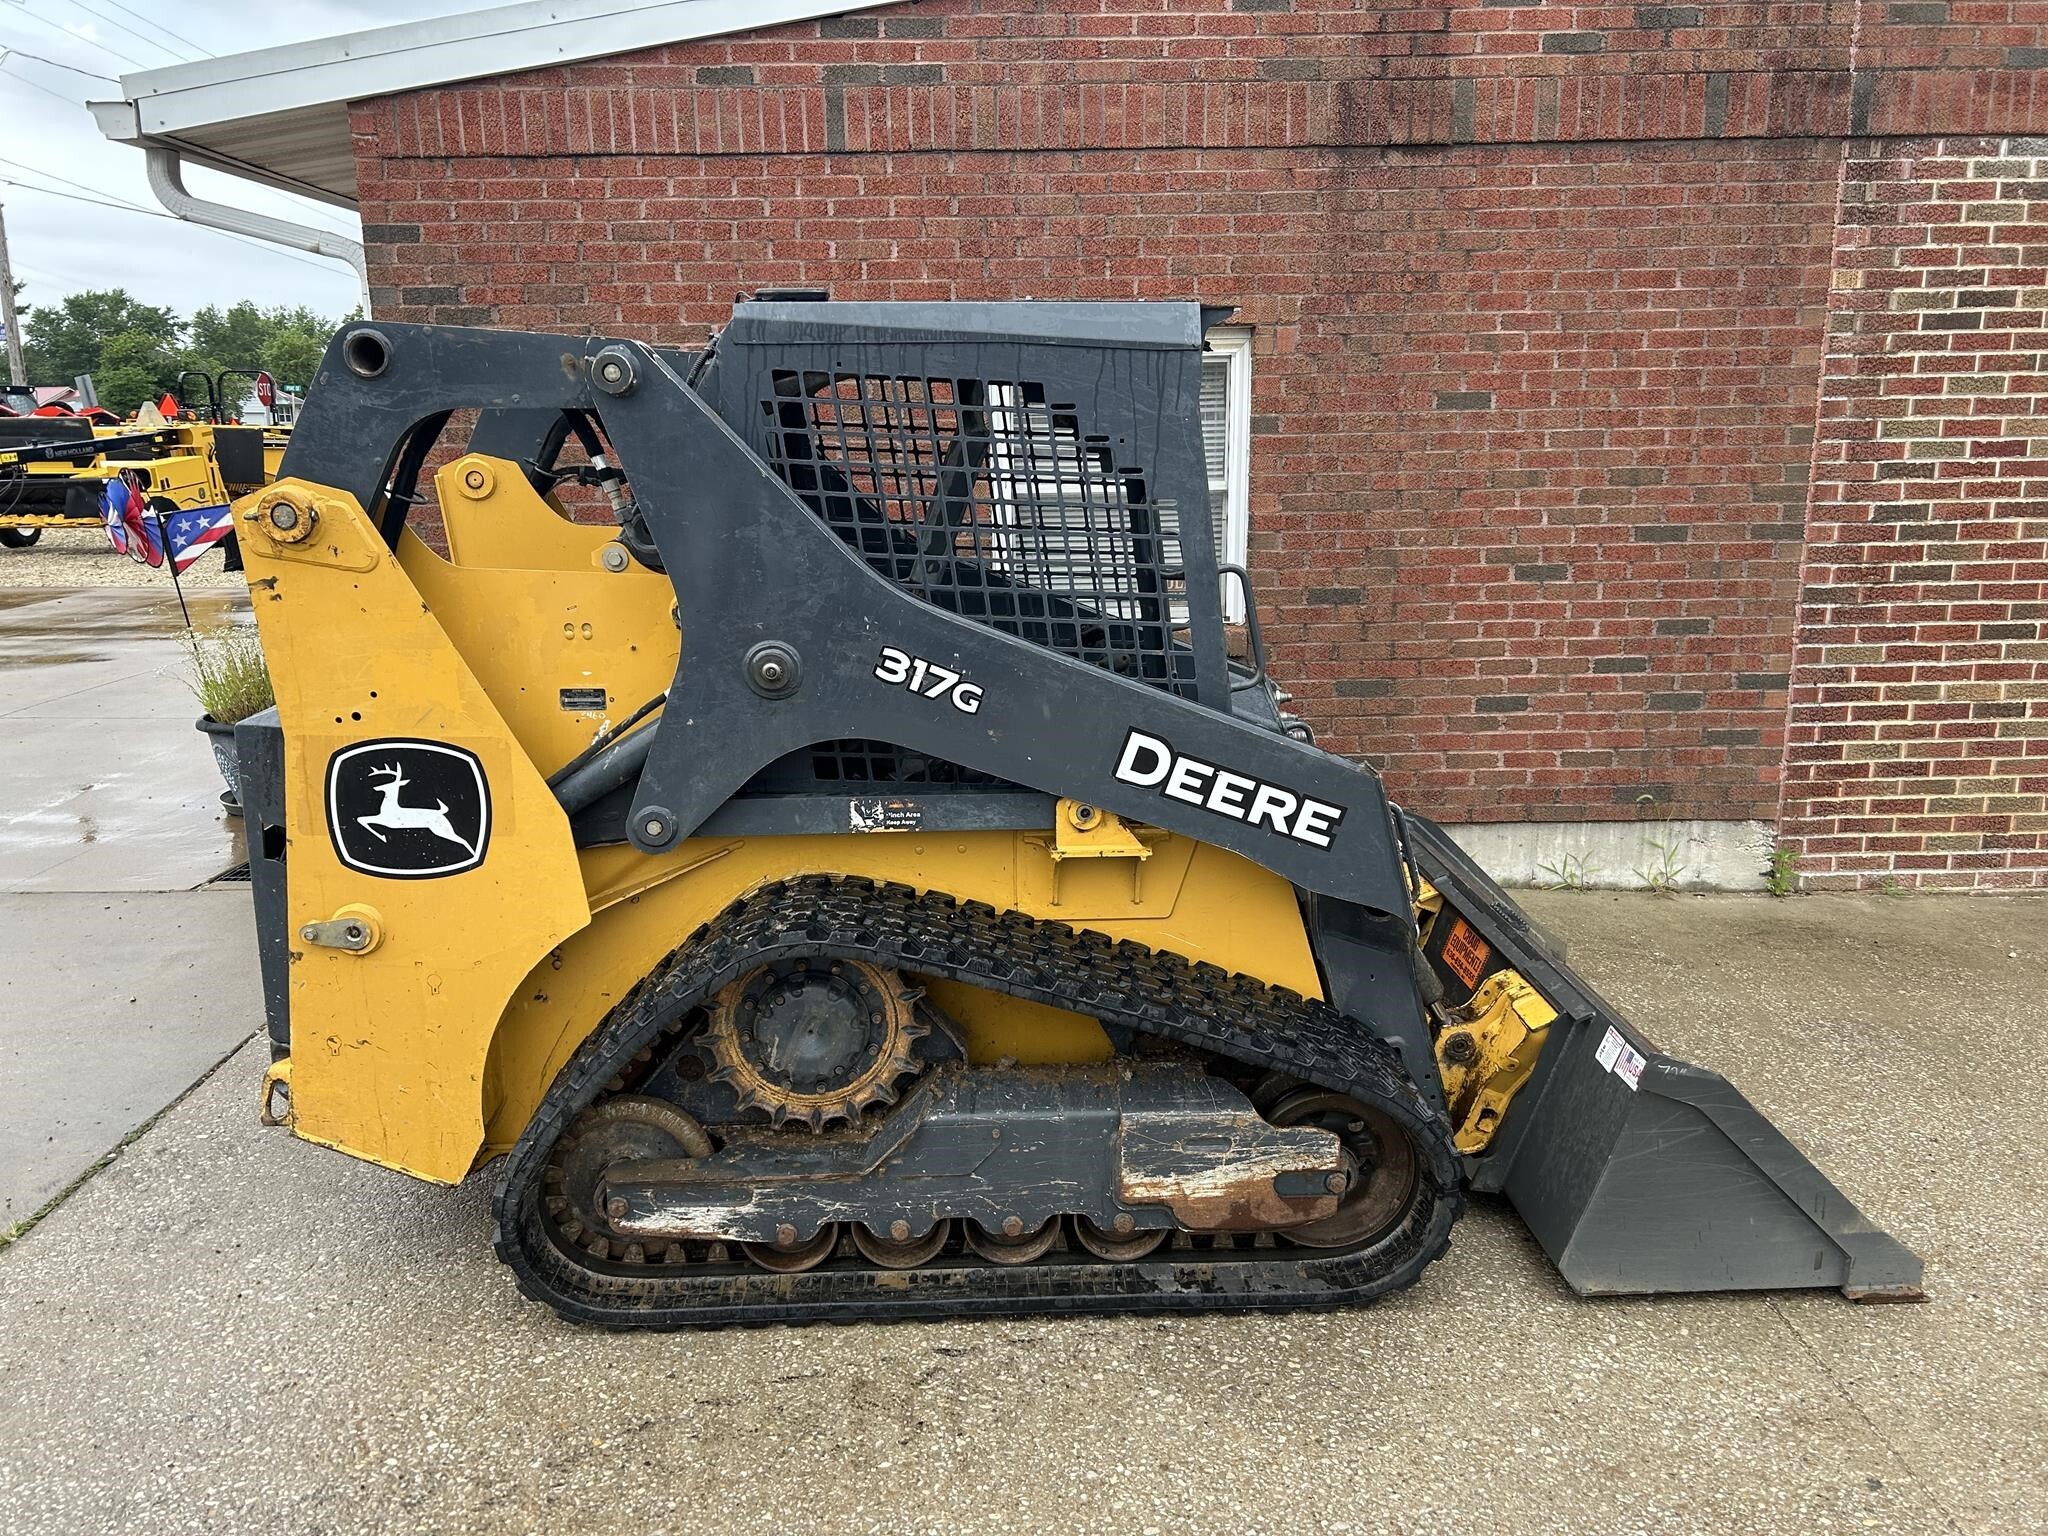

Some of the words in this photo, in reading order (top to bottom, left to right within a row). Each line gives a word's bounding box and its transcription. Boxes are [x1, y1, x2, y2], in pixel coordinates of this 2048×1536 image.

[258, 383, 272, 396] STO
[68, 447, 95, 456] HOLLAND
[874, 647, 983, 714] 317G
[1115, 731, 1342, 848] DEERE
